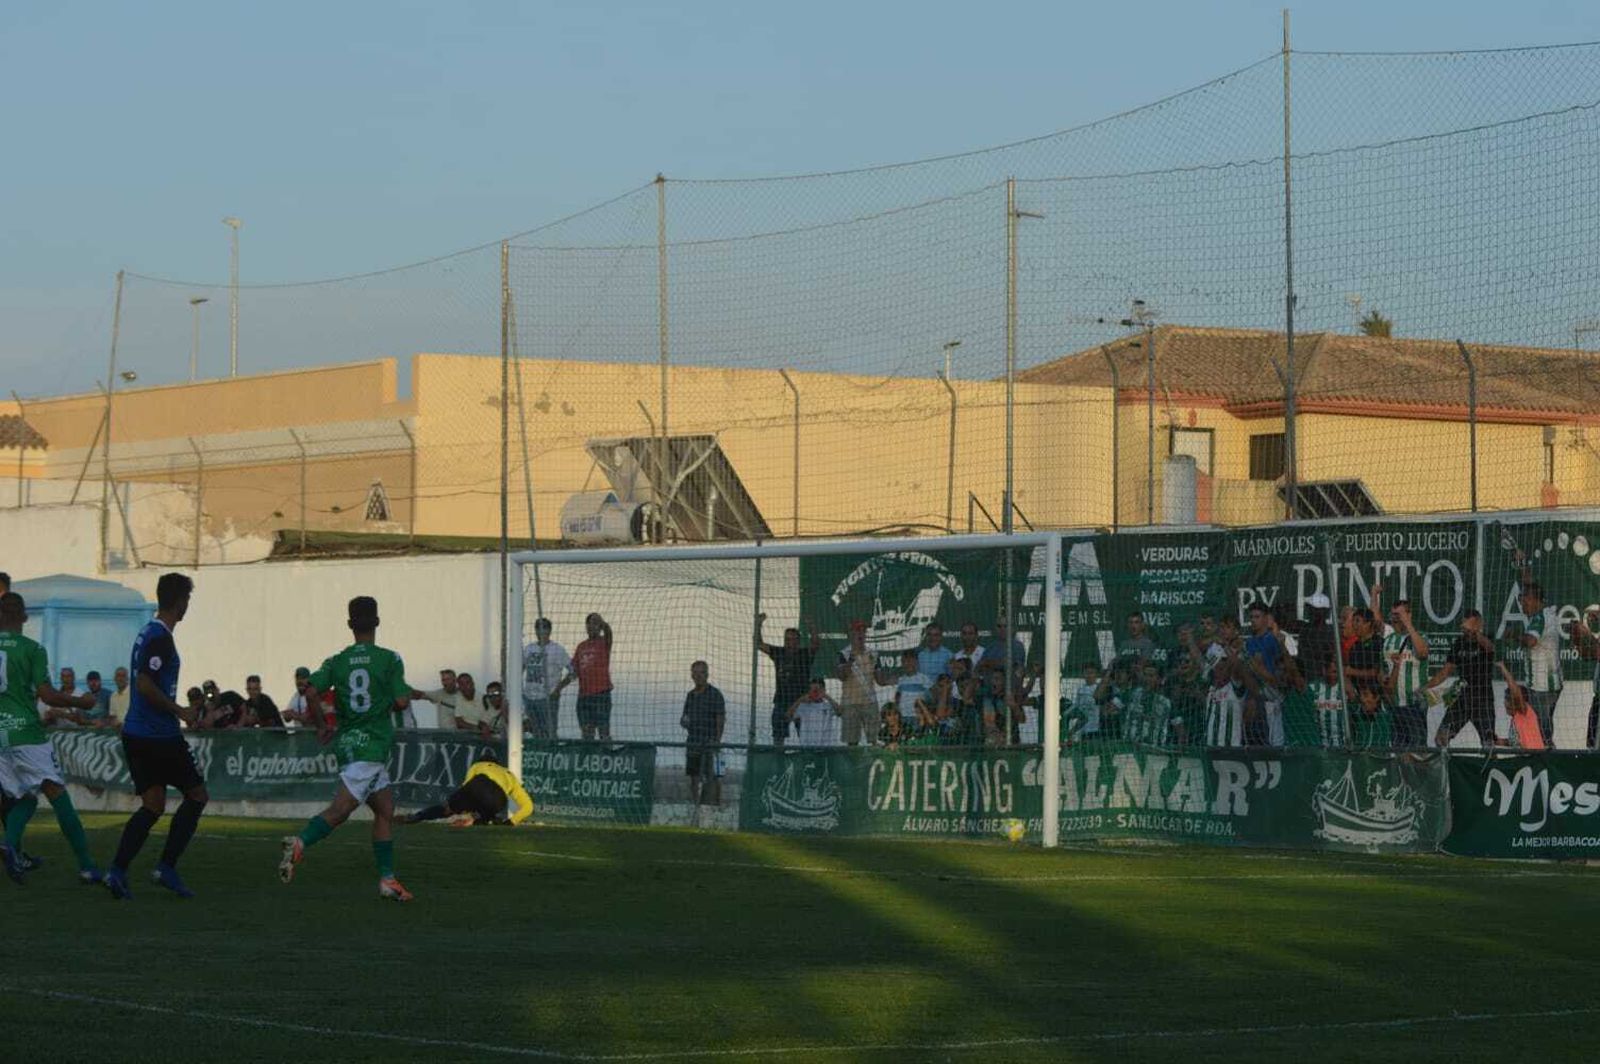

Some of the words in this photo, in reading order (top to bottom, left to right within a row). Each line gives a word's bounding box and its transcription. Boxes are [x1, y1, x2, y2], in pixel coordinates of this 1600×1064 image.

[1345, 531, 1403, 551] PUERTO
[1407, 529, 1470, 551] LUCERO
[1140, 546, 1209, 562] VERDURAS
[1139, 589, 1205, 606] MARISCOS
[348, 667, 372, 714] 8
[225, 745, 244, 776] el
[573, 753, 638, 774] LABORAL
[571, 778, 642, 799] CONTABLE
[867, 758, 1014, 814] CATERING
[1511, 836, 1524, 848] LA
